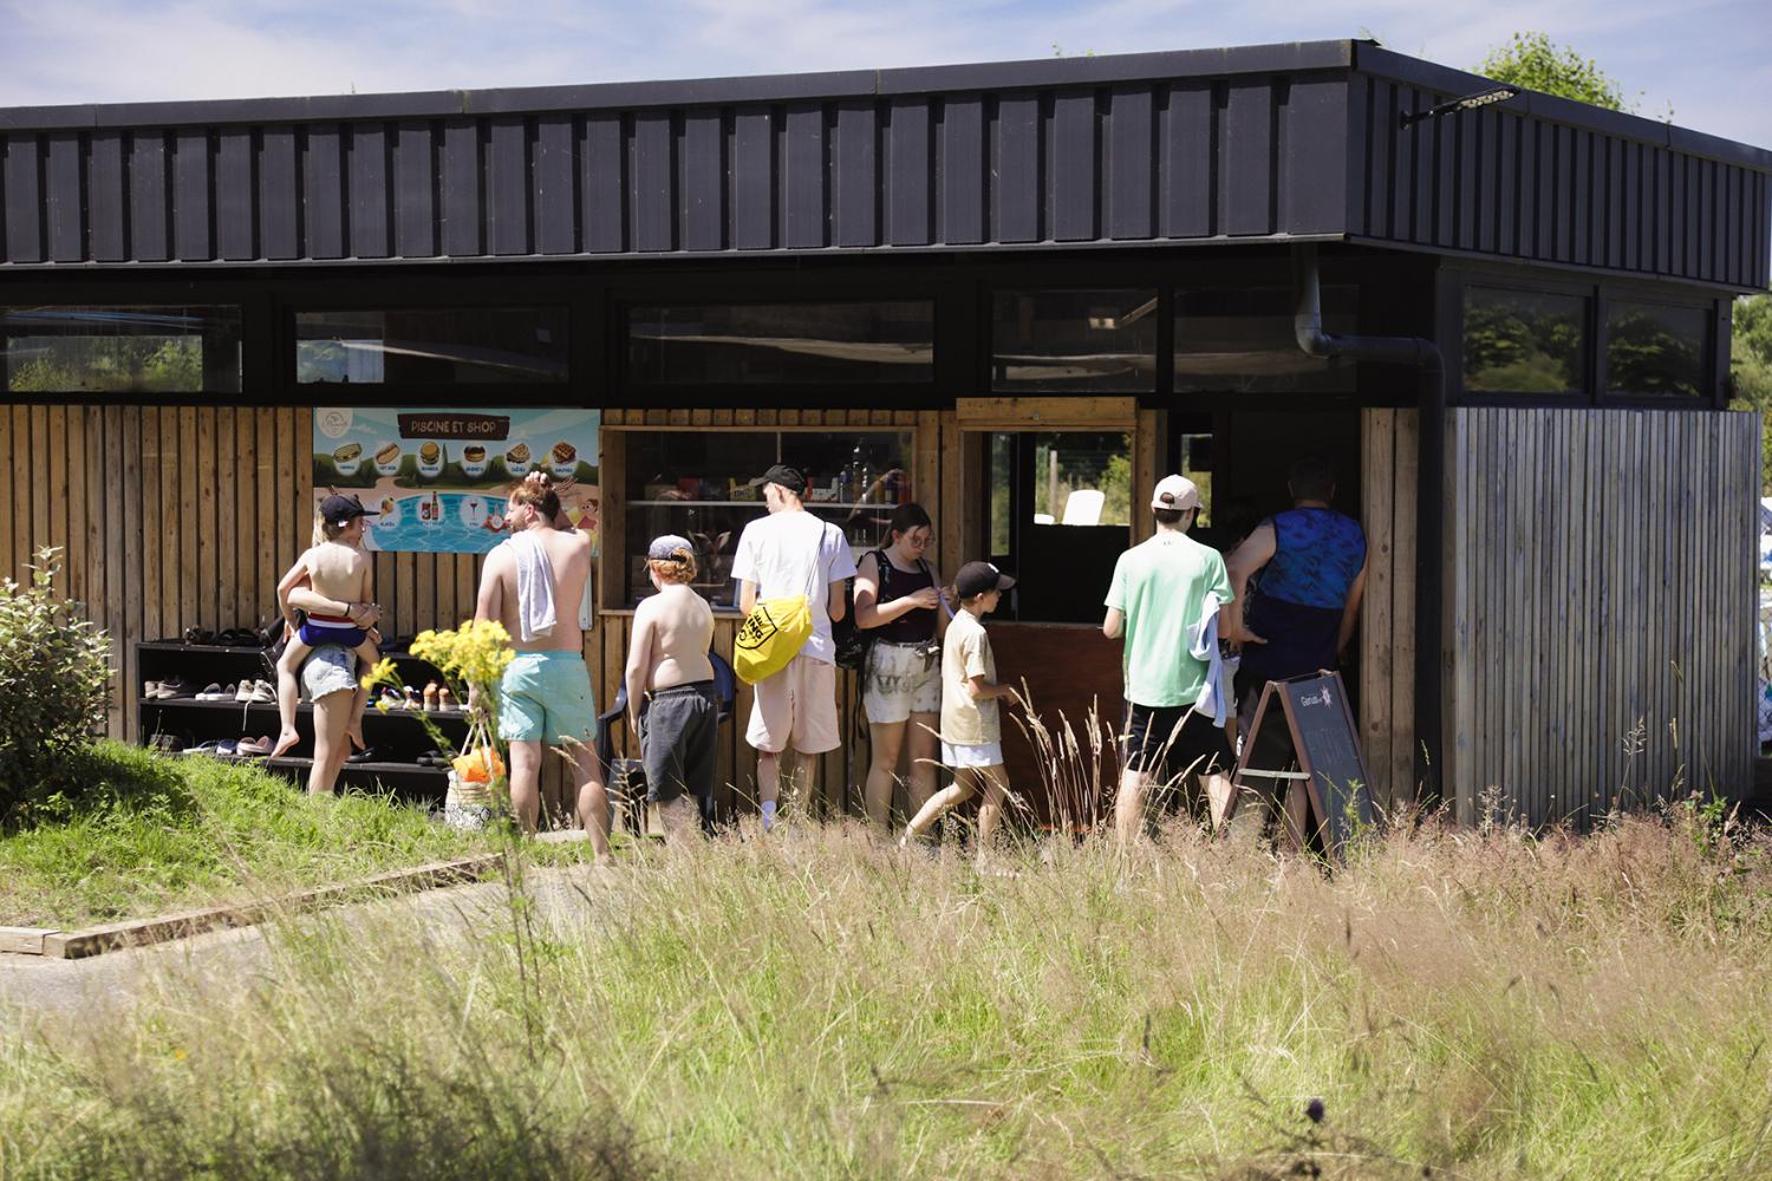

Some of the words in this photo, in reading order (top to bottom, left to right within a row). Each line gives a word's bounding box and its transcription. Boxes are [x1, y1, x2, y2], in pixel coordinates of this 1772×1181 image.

[411, 420, 450, 433] PISCINE
[451, 421, 465, 433] ET
[467, 421, 496, 433] SHOP
